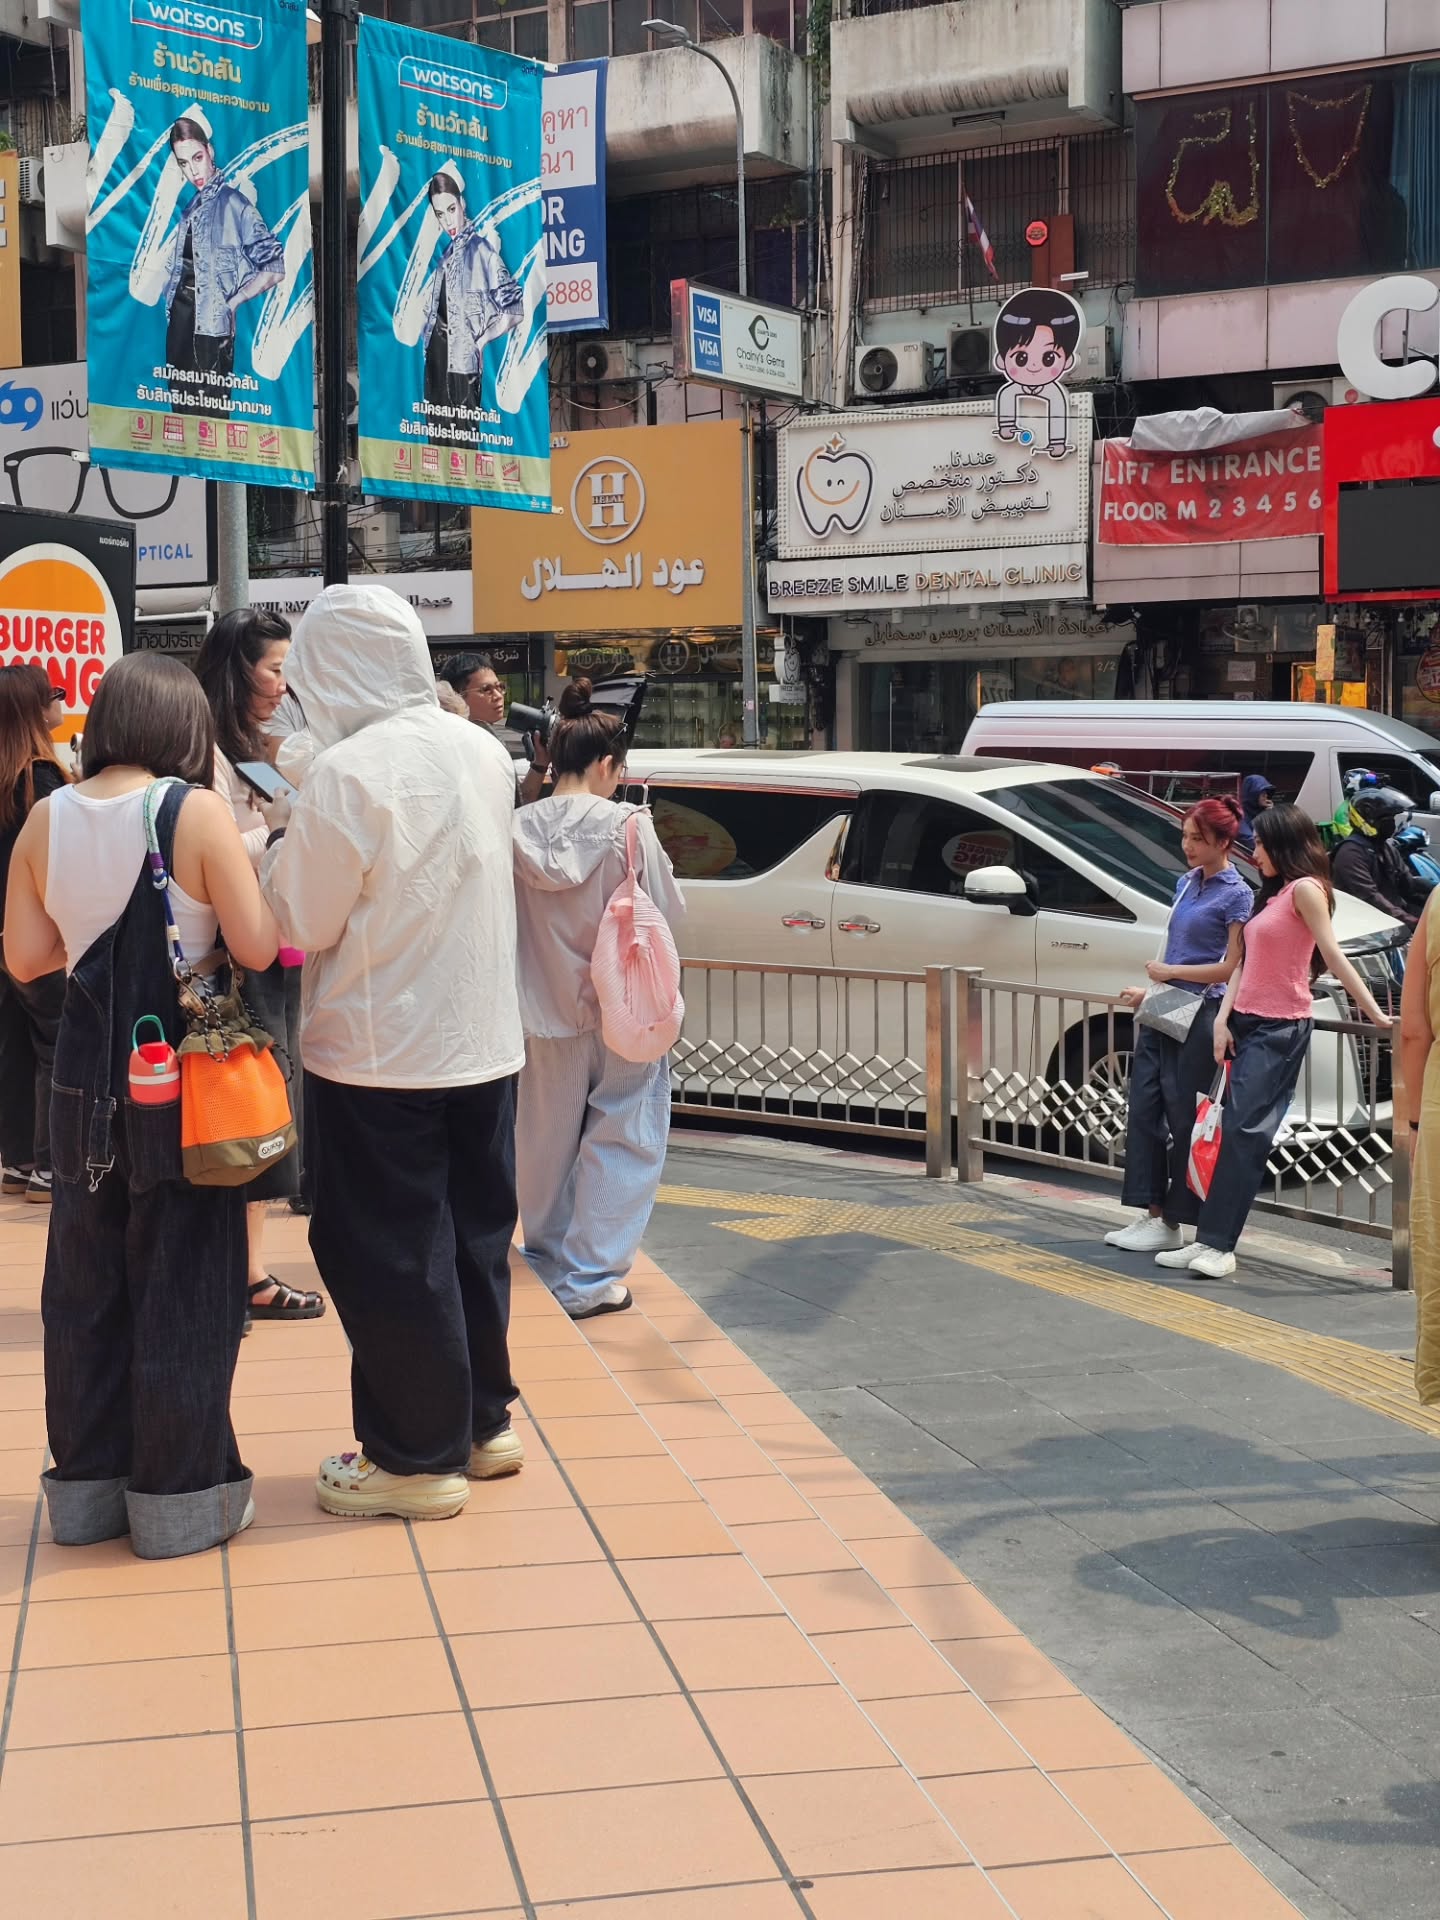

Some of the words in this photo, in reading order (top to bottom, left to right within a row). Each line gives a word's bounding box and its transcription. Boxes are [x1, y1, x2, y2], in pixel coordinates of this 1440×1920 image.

[149, 1, 246, 38] watsons
[153, 42, 242, 84] ร้านวัตสัน
[412, 66, 494, 100] watsons
[416, 103, 489, 142] ร้านวัตสัน
[696, 305, 718, 325] VISA
[698, 338, 719, 357] VISA
[152, 363, 259, 391] สมัครสมาชิกวัตสัน
[136, 383, 272, 416] รับสิทธิประโยชน์มากมาย
[412, 399, 501, 424] สมัครสมาชิกวัตสัน
[400, 418, 513, 446] รับสิทธิประโยชน์มากมาย
[1104, 460, 1154, 486] LIFT
[1170, 445, 1321, 484] ENTRANCE
[1104, 501, 1167, 521] FLOOR
[1177, 499, 1197, 520] M
[1208, 498, 1222, 518] 2
[1232, 496, 1246, 517] 3
[1256, 494, 1272, 514] 4
[1283, 491, 1297, 512] 5
[1308, 489, 1322, 510] 6
[653, 558, 706, 595] عود
[769, 578, 843, 597] BREEZE
[847, 574, 909, 593] SMILE
[915, 569, 999, 590] DENTAL
[1003, 563, 1083, 585] CLINIC
[0, 615, 105, 655] BURGER
[0, 655, 104, 708] NG
